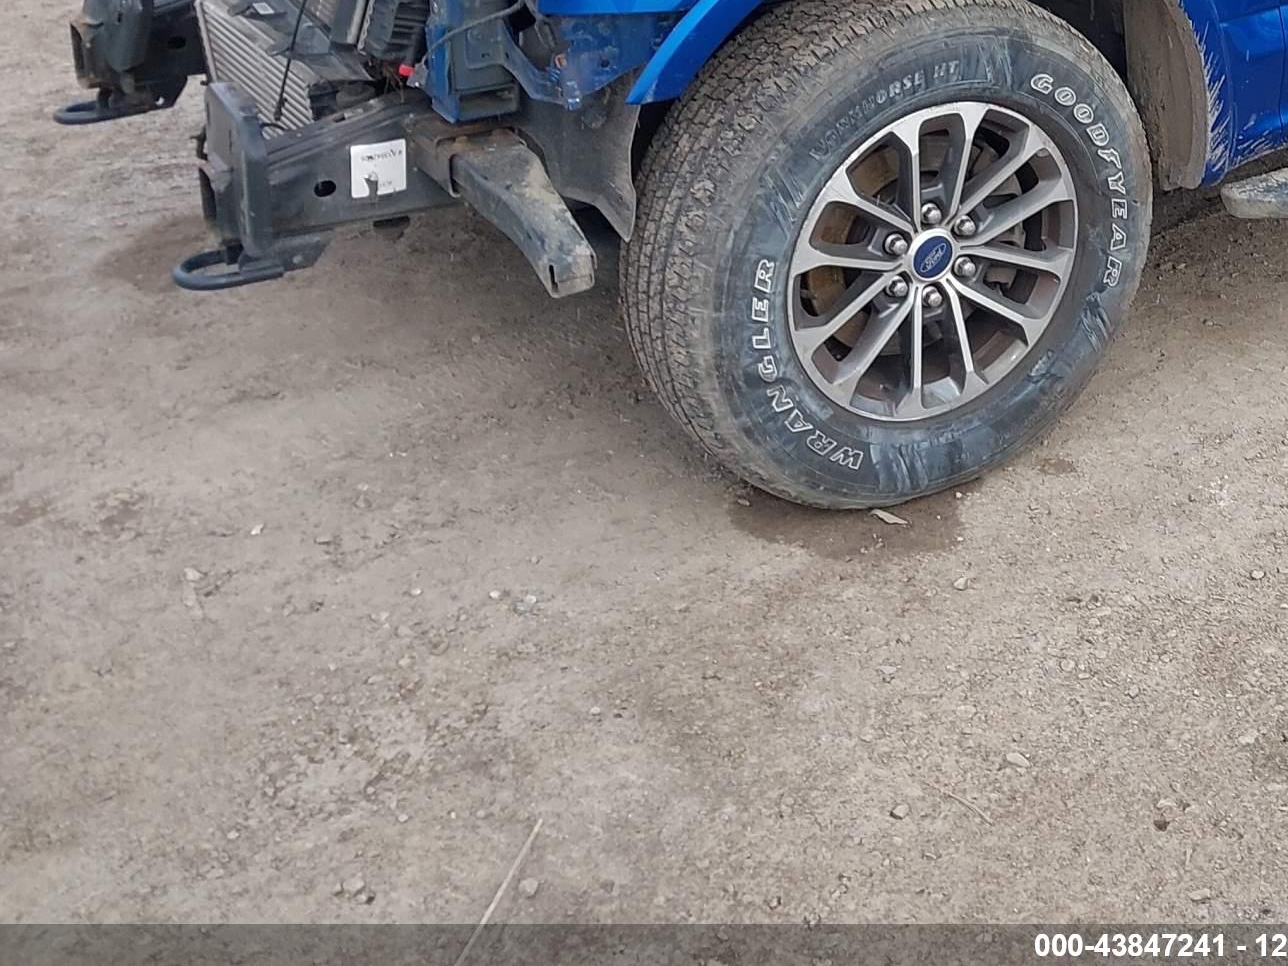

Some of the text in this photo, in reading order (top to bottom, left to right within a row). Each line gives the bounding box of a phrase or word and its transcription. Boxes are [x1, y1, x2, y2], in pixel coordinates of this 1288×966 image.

[932, 60, 961, 80] HT
[1030, 73, 1129, 288] GOODYEAR
[920, 245, 946, 271] Ford
[750, 258, 864, 471] WRANGLER
